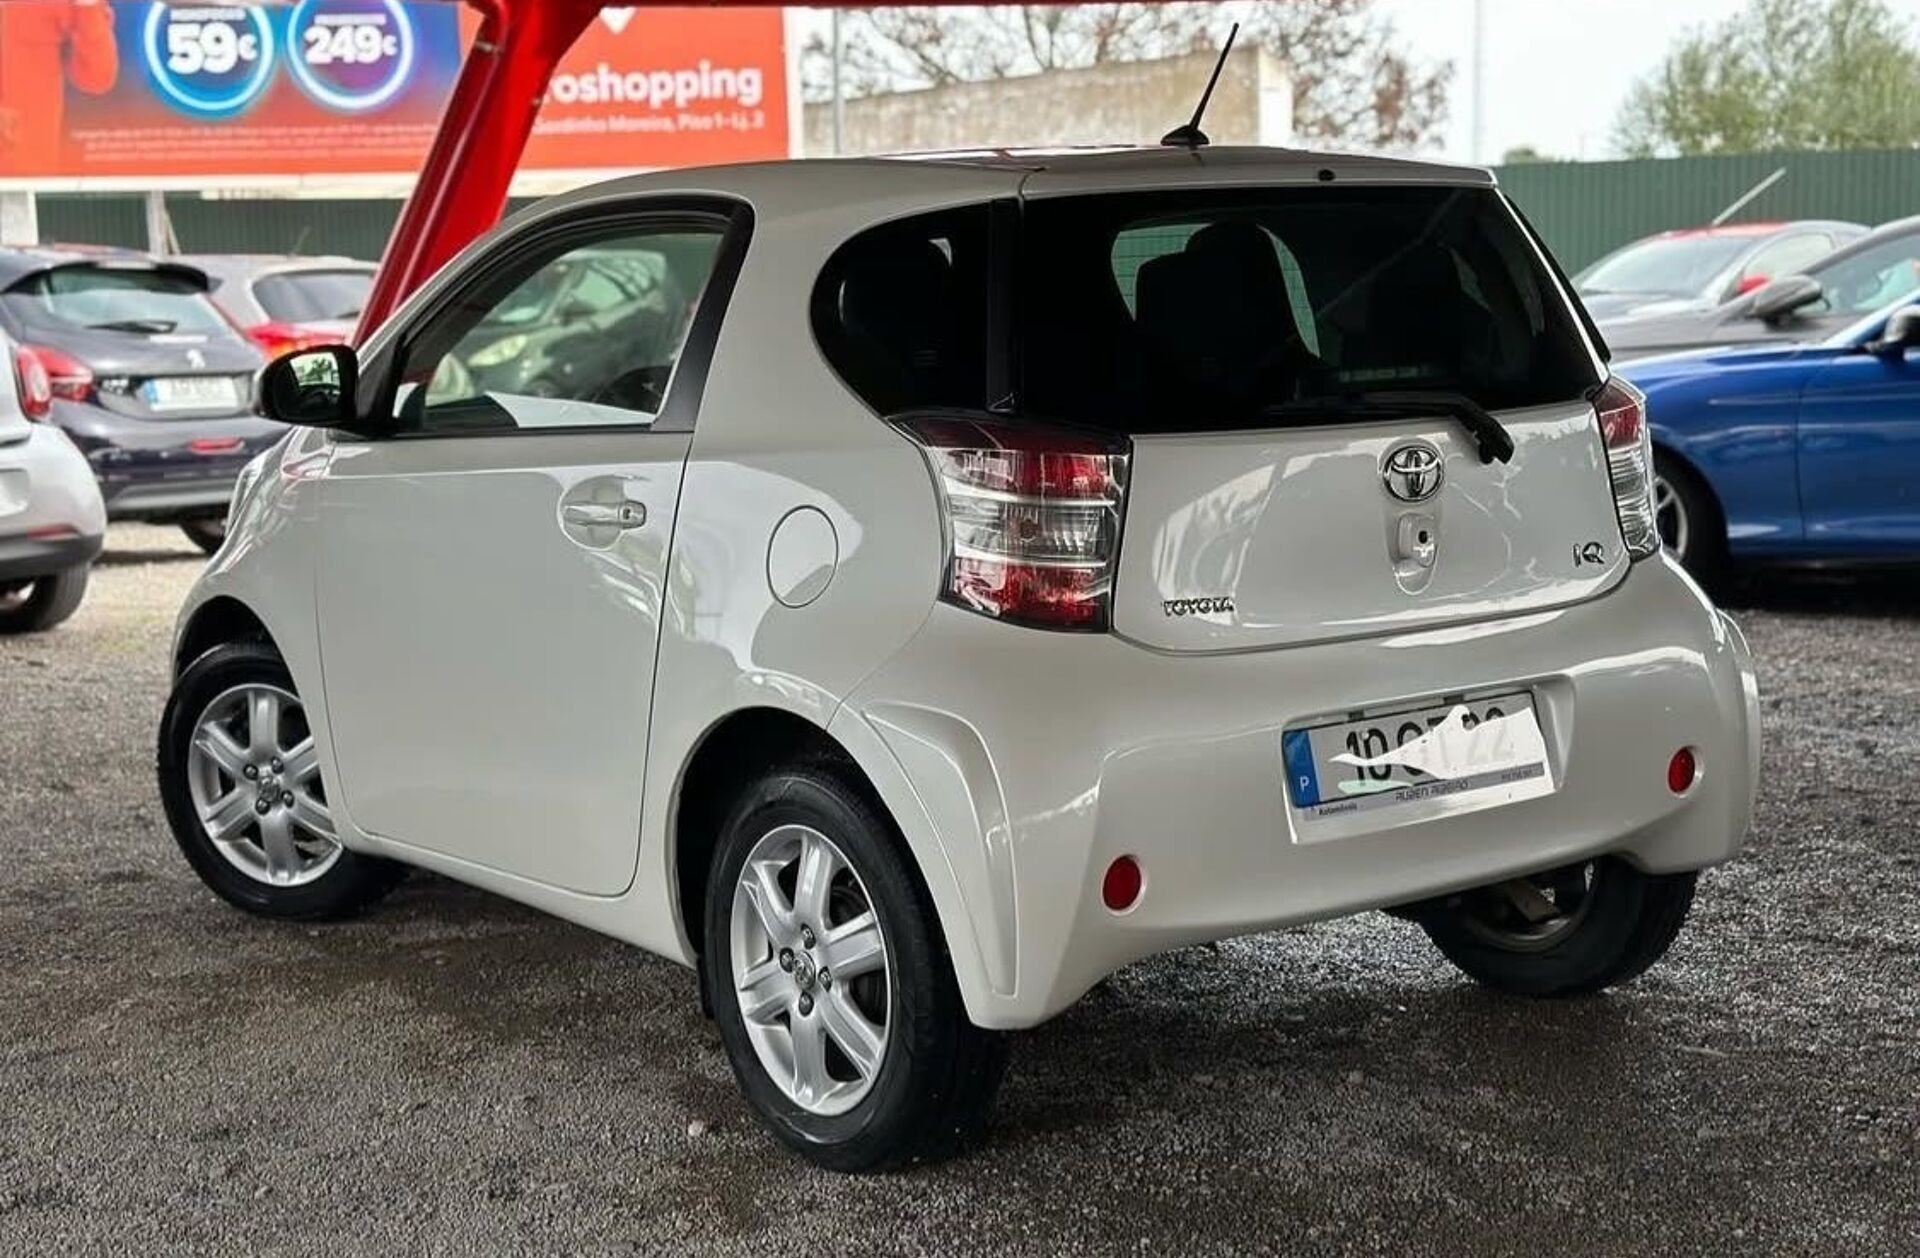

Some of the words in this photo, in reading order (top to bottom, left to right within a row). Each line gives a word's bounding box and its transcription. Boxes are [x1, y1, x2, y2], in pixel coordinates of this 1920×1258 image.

[168, 21, 257, 74] 59€
[304, 25, 397, 64] 249€
[546, 61, 763, 109] oshopping
[1164, 597, 1234, 616] TOYOTA
[1300, 775, 1310, 792] P
